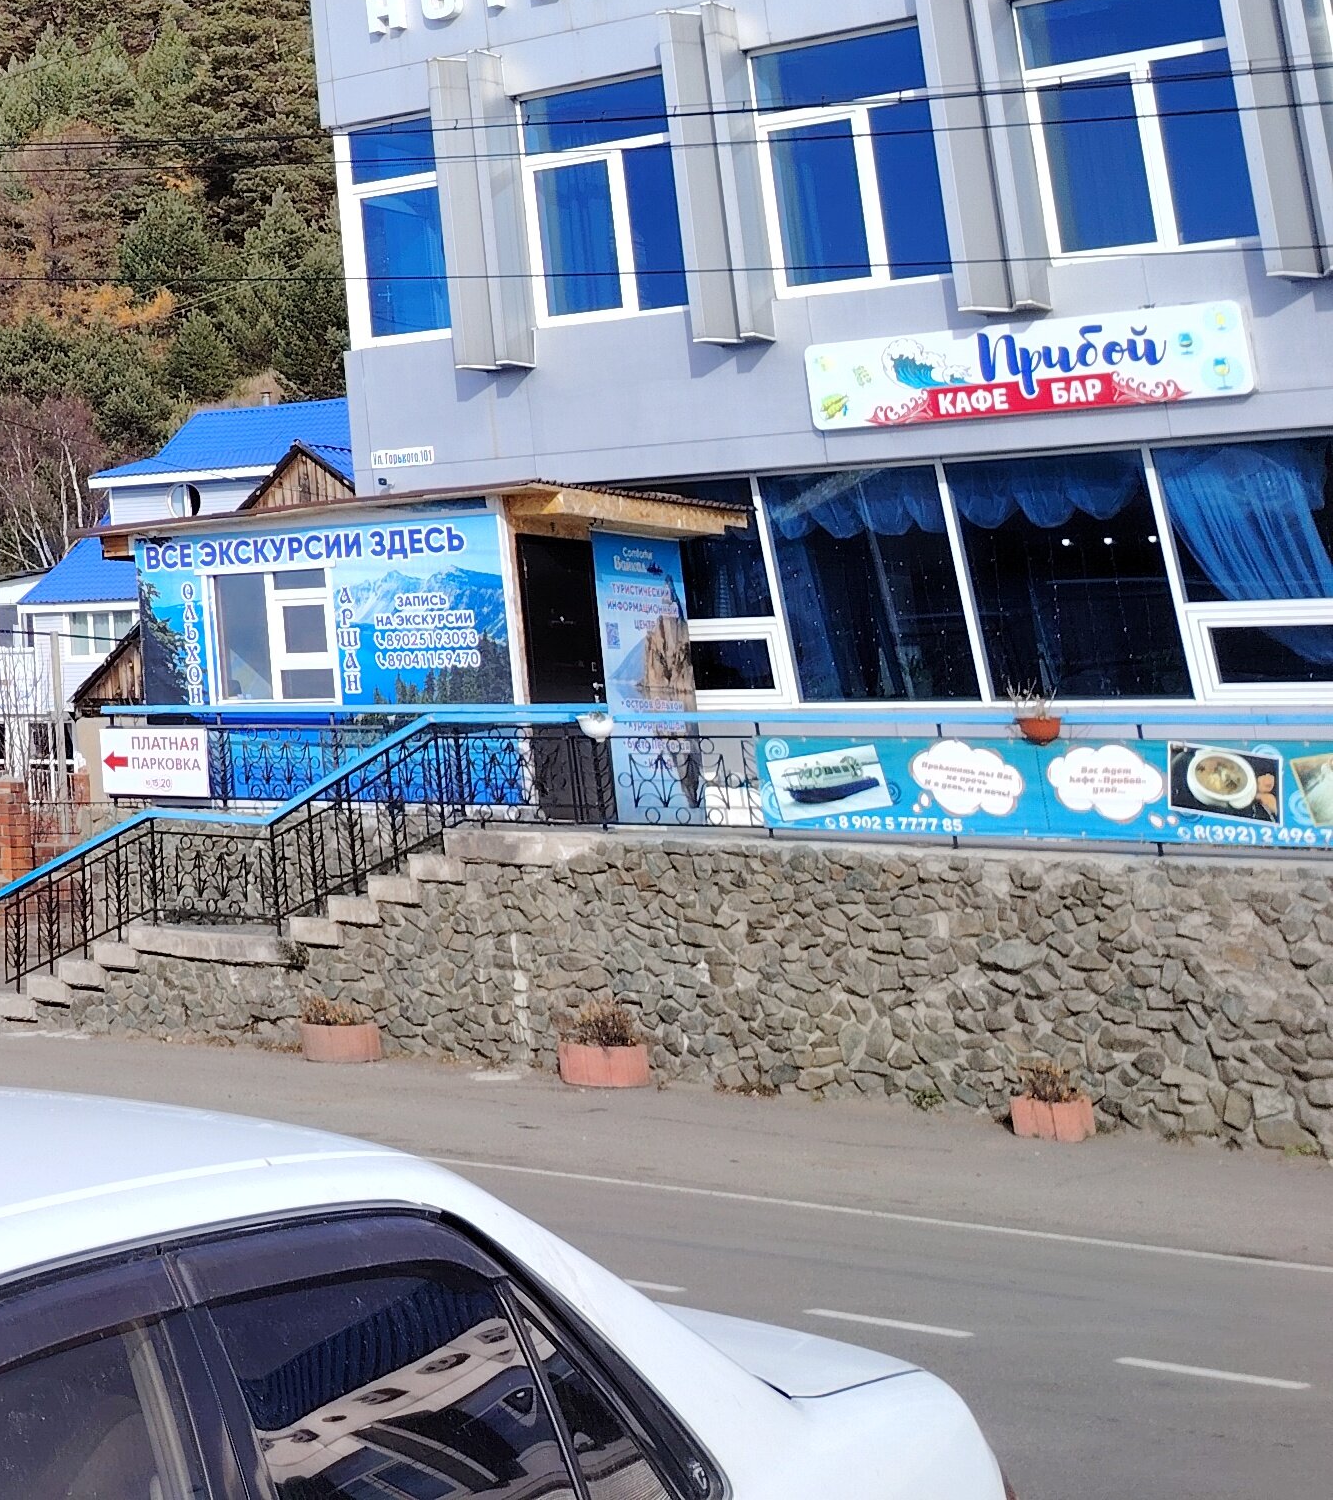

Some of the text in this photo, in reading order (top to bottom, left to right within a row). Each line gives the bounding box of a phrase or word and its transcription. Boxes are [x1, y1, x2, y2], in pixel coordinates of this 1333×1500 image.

[976, 324, 1167, 396] Прибой
[937, 378, 1102, 415] КАФЕ БАР
[145, 526, 465, 570] ВСЕ ЭКСКУРСИИ ЗДЕСЬ
[611, 583, 670, 597] ТУРИСТИЧЕСКИЙ
[396, 594, 447, 607] ЗАПИСЬ
[376, 612, 472, 626] НА ЭКСКУРСИИ
[183, 583, 201, 703] ОЛЬХОН
[340, 586, 359, 691] АРШАН
[386, 631, 477, 647] 89025193093
[387, 651, 479, 667] 89041159470
[131, 736, 199, 751] ПЛАТНАЯ
[131, 756, 201, 771] ПАРКОВКА
[160, 778, 171, 788] 20
[838, 815, 963, 832] 8 902 5 7777 85
